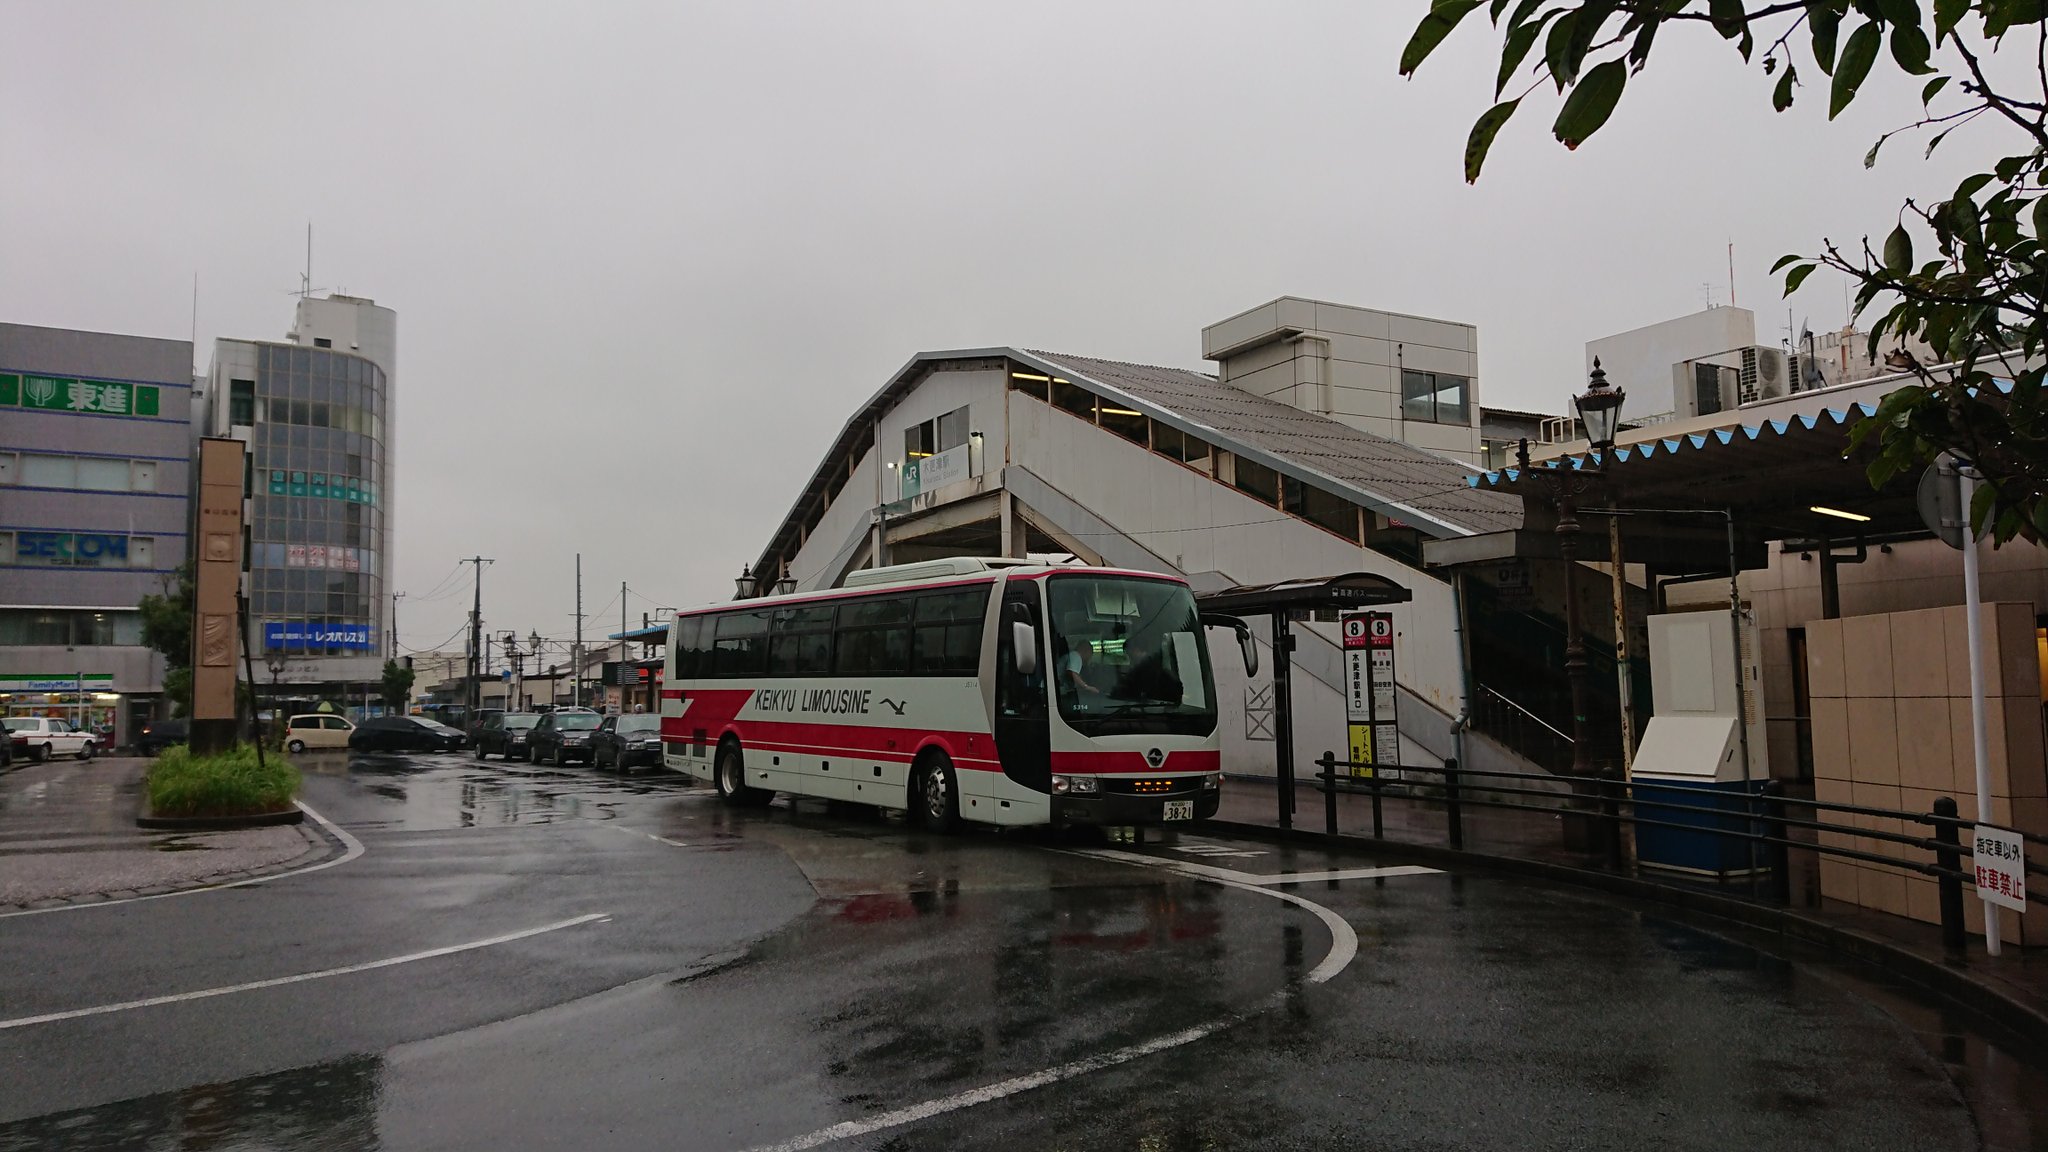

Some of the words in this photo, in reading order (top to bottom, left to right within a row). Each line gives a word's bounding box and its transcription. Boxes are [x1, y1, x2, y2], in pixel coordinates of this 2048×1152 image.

[67, 382, 127, 413] 東進
[906, 466, 917, 480] JR
[17, 532, 128, 560] SECOM
[1350, 622, 1359, 636] 8
[1376, 621, 1385, 635] 8
[28, 681, 75, 690] FamilyMart
[1352, 653, 1362, 709] 木更津駅東口
[754, 688, 796, 712] KEIKYU
[801, 689, 872, 714] LIMOUSINE
[1976, 837, 2020, 862] 指定車以外
[1976, 865, 2023, 900] 駐車禁止
